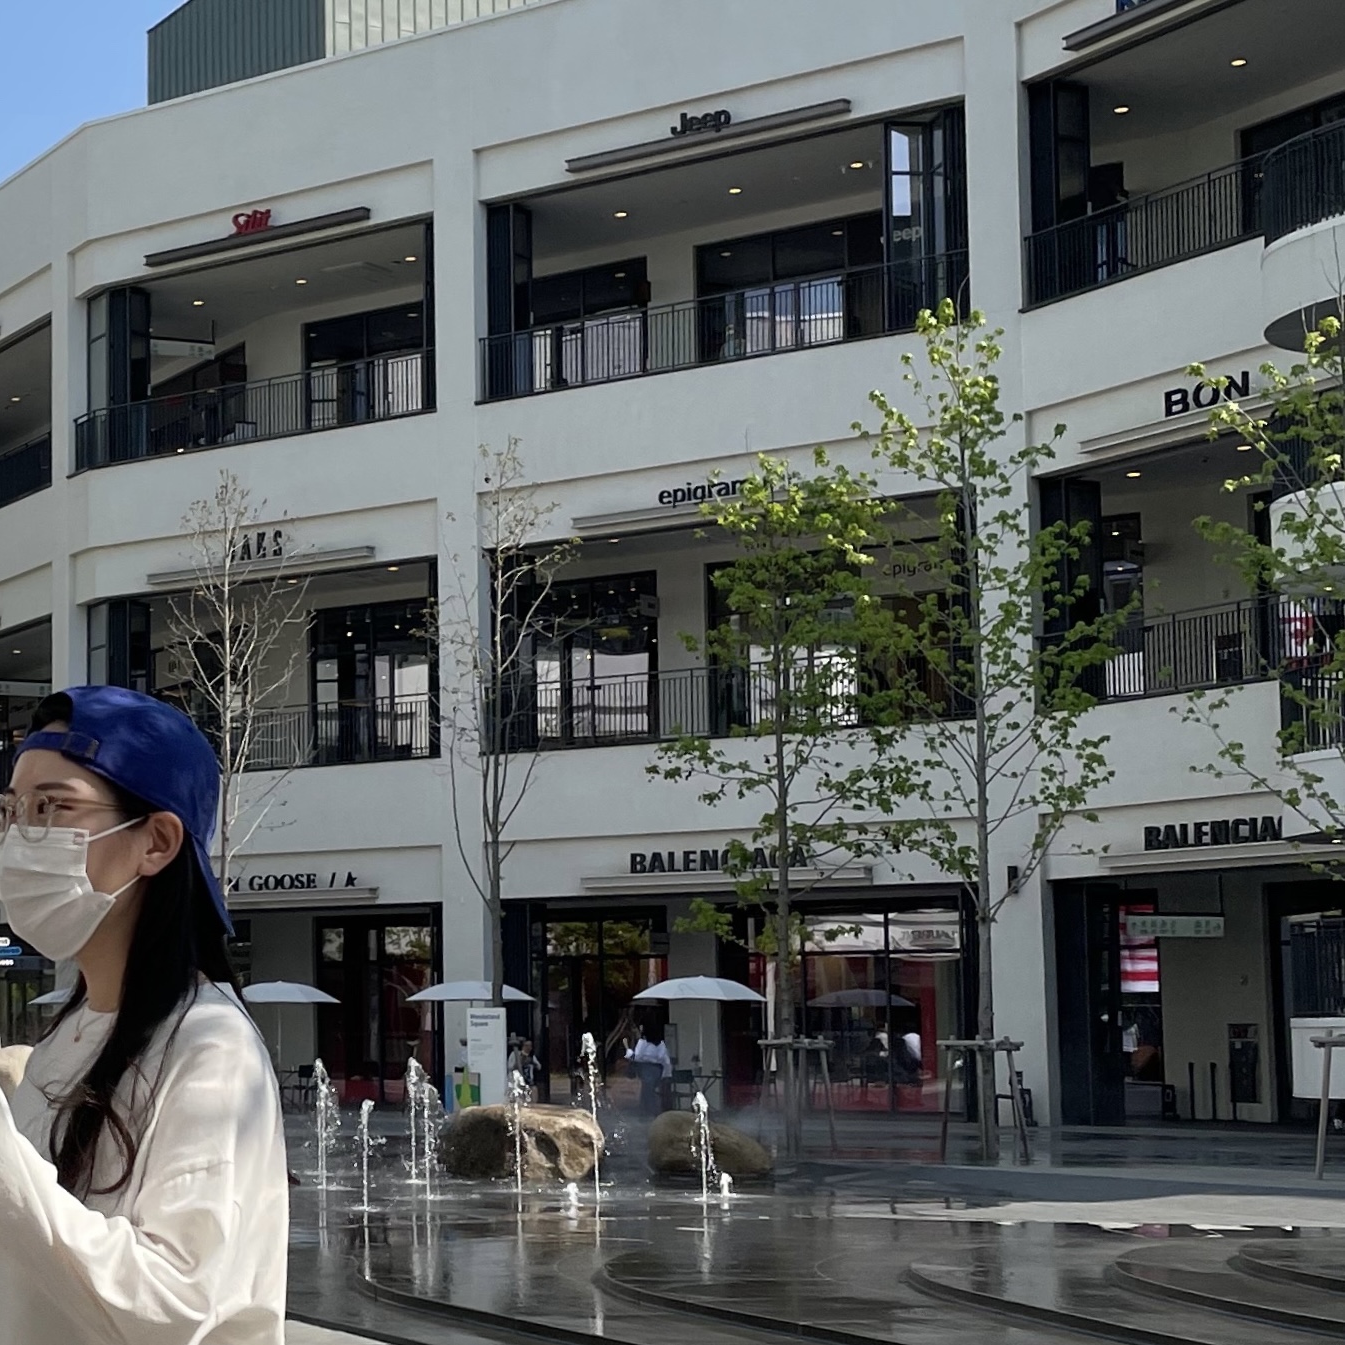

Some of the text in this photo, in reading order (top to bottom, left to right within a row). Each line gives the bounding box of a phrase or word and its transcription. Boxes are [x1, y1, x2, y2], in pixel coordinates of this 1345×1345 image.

[670, 109, 731, 136] Jeep
[1165, 371, 1250, 418] BON
[1144, 815, 1283, 851] BALENCIA
[248, 873, 317, 892] GOOSE
